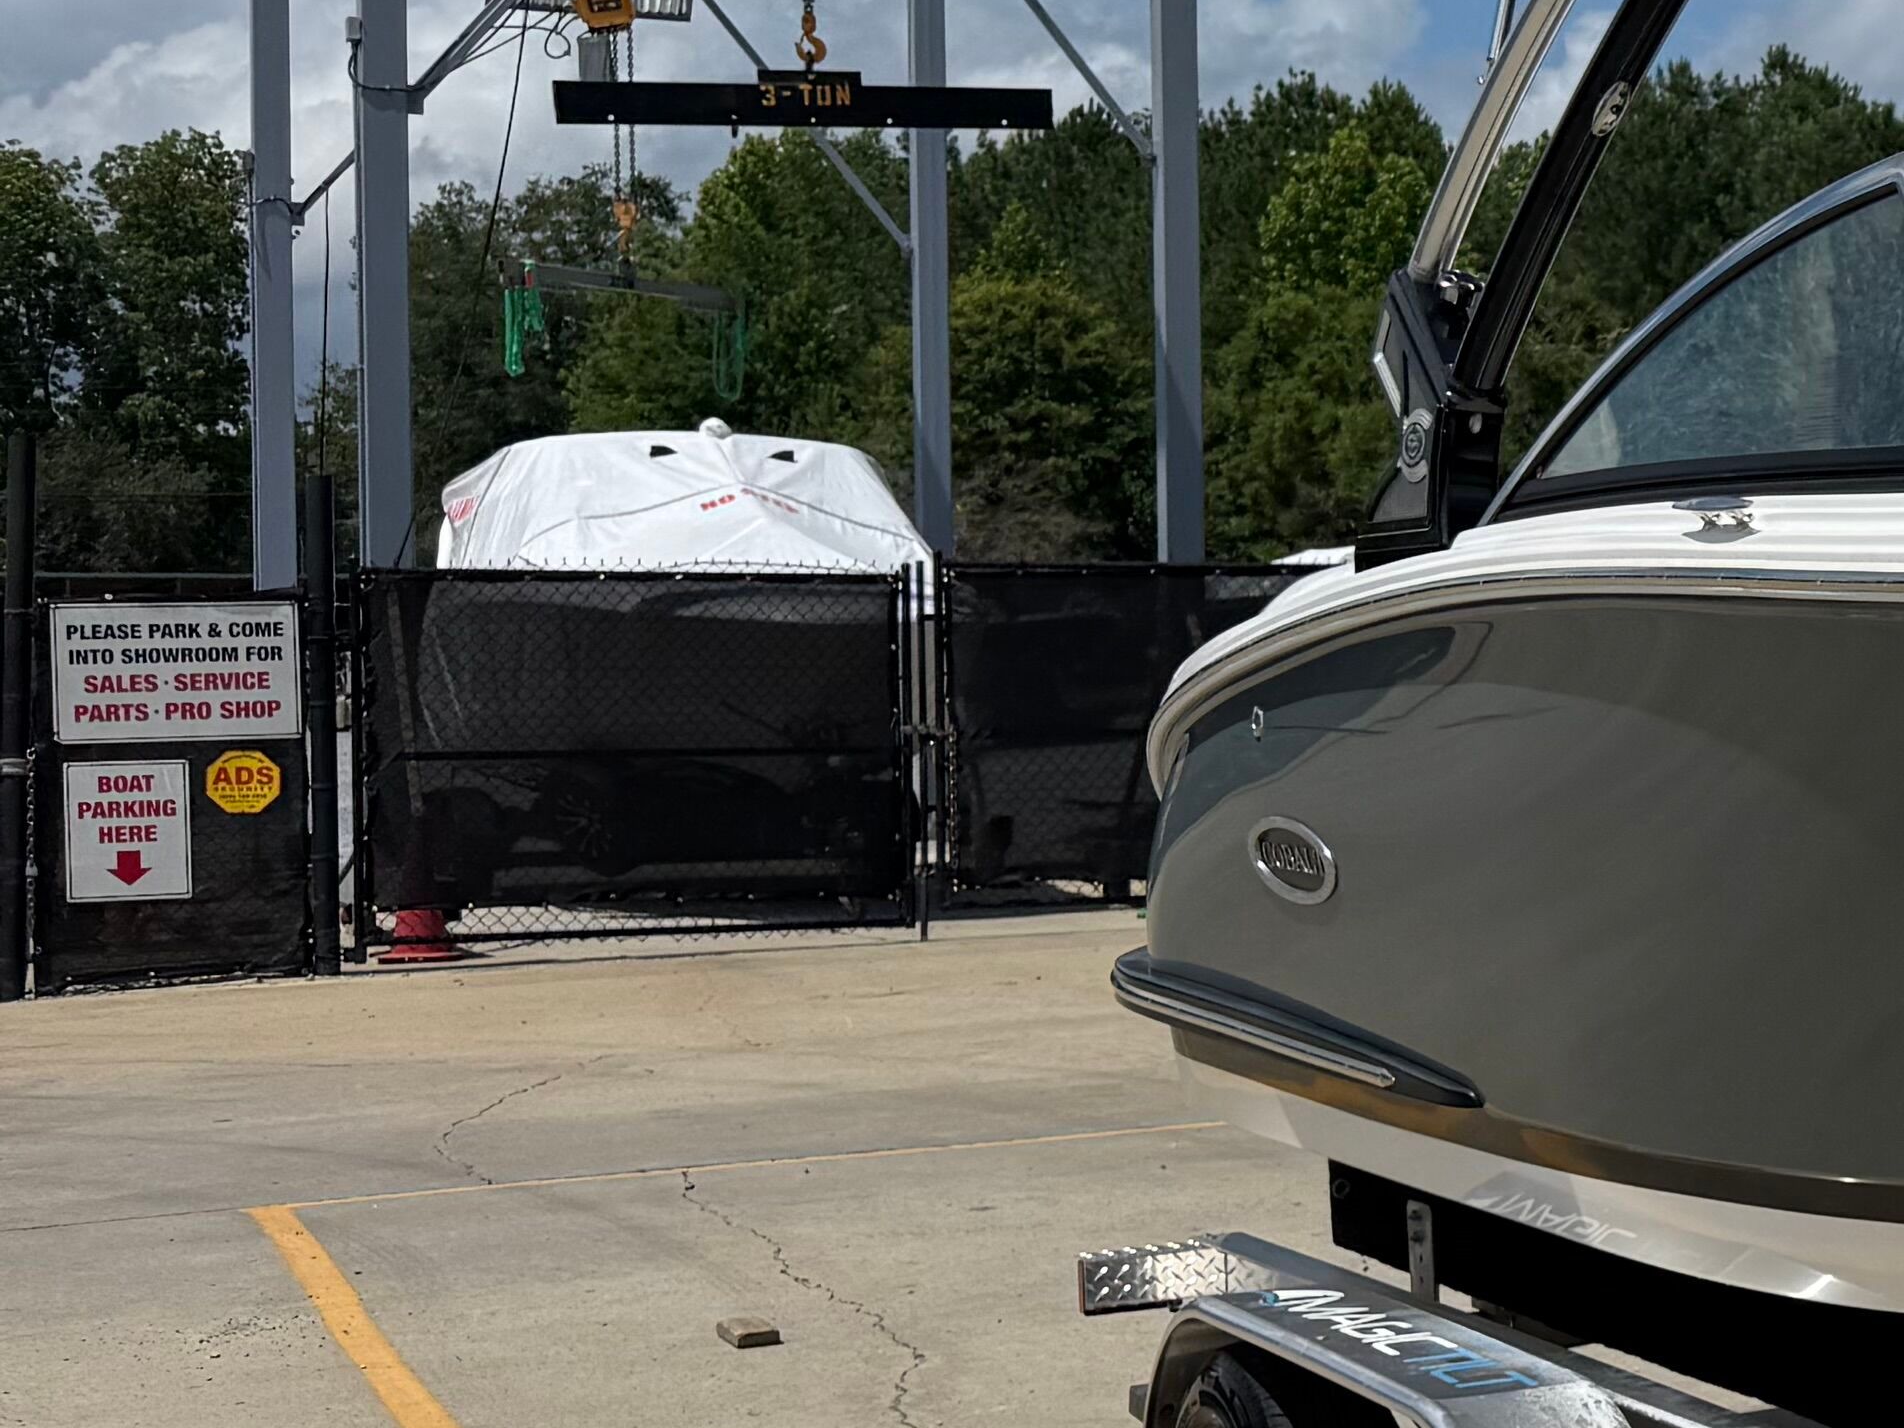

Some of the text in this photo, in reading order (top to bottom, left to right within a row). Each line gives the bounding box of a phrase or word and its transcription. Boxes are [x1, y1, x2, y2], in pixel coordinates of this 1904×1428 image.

[66, 622, 284, 640] PLEASE PARK & COME
[68, 646, 283, 665] INTO SHOWROOM FOR
[84, 671, 271, 694] SALES SERVICE
[74, 700, 282, 723] PARTS PRO SHOP
[98, 775, 155, 793] BOAT
[213, 766, 273, 785] ADS
[78, 799, 177, 819] PARKING
[99, 825, 158, 844] HERE
[1261, 842, 1324, 876] COBALT
